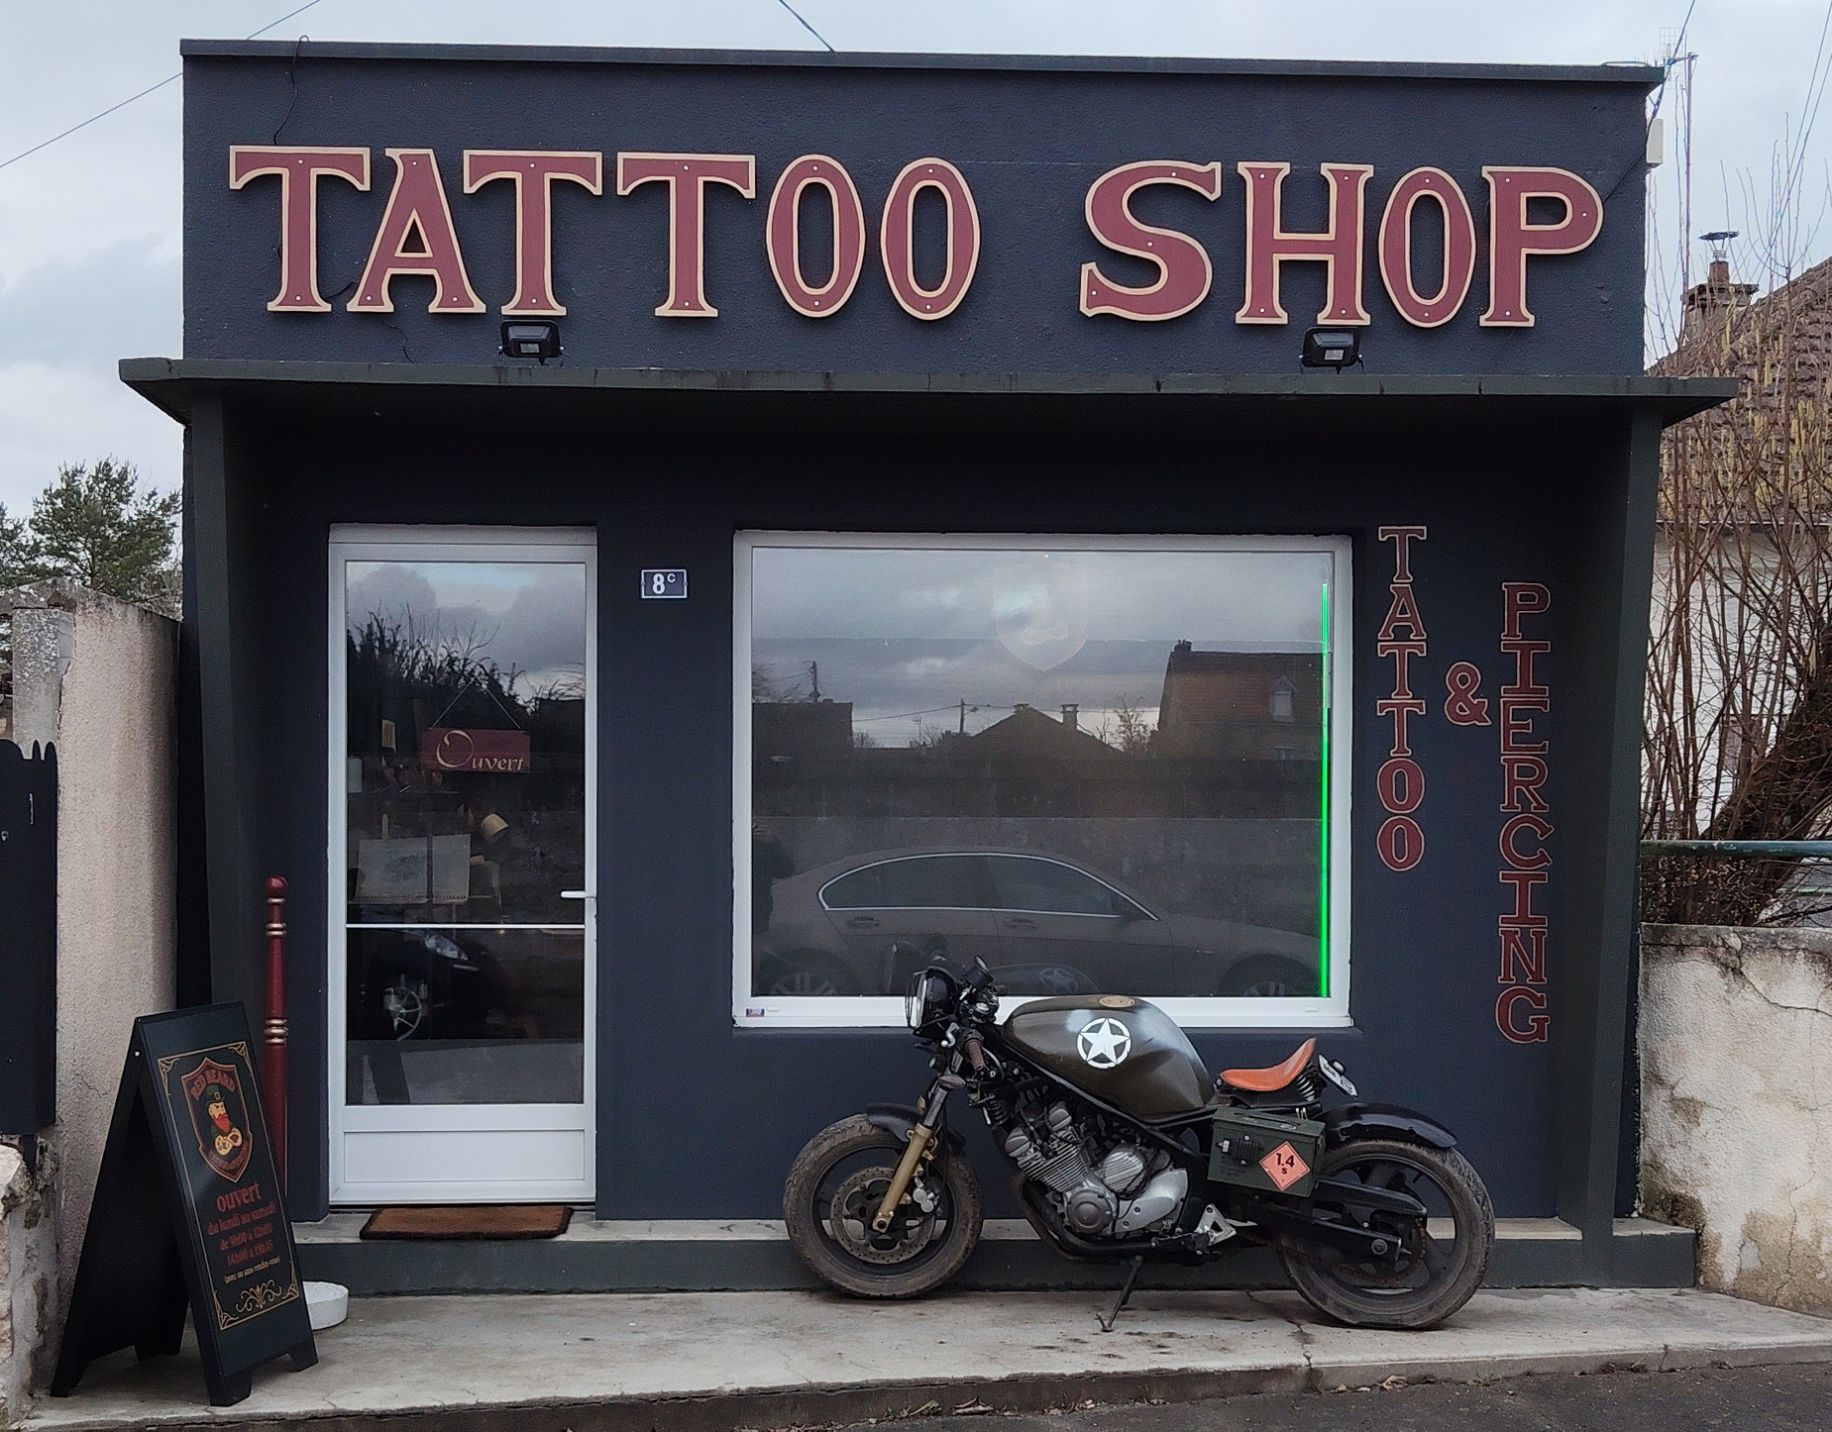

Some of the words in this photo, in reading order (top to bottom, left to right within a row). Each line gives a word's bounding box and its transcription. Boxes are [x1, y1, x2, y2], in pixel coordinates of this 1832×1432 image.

[229, 145, 981, 321] TATTOO
[1079, 160, 1604, 328] SHOP
[1377, 526, 1427, 871] TATTOO
[1444, 661, 1492, 726] &
[436, 729, 525, 771] Ouvert
[1495, 582, 1554, 1043] PIERCING
[1276, 1153, 1295, 1168] 1.4
[216, 1182, 262, 1213] ouvert
